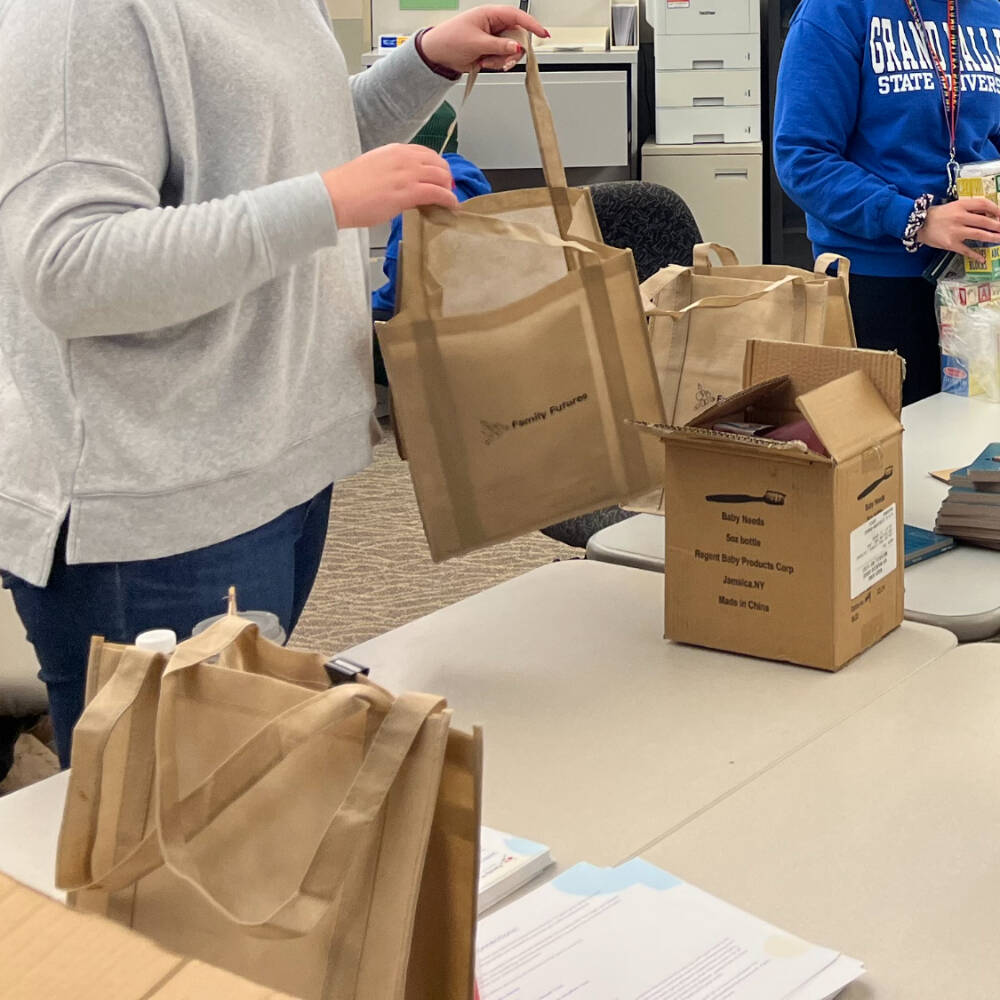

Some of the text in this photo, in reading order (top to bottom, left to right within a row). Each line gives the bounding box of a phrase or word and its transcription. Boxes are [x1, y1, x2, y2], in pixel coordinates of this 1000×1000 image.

[870, 16, 946, 74] GRAND
[878, 72, 935, 95] STATE
[512, 393, 588, 429] Family Futures
[722, 512, 764, 526] Baby Needs
[740, 536, 761, 547] bottle
[695, 549, 794, 575] Regent Baby Products Corp
[719, 595, 769, 612] Made in China
